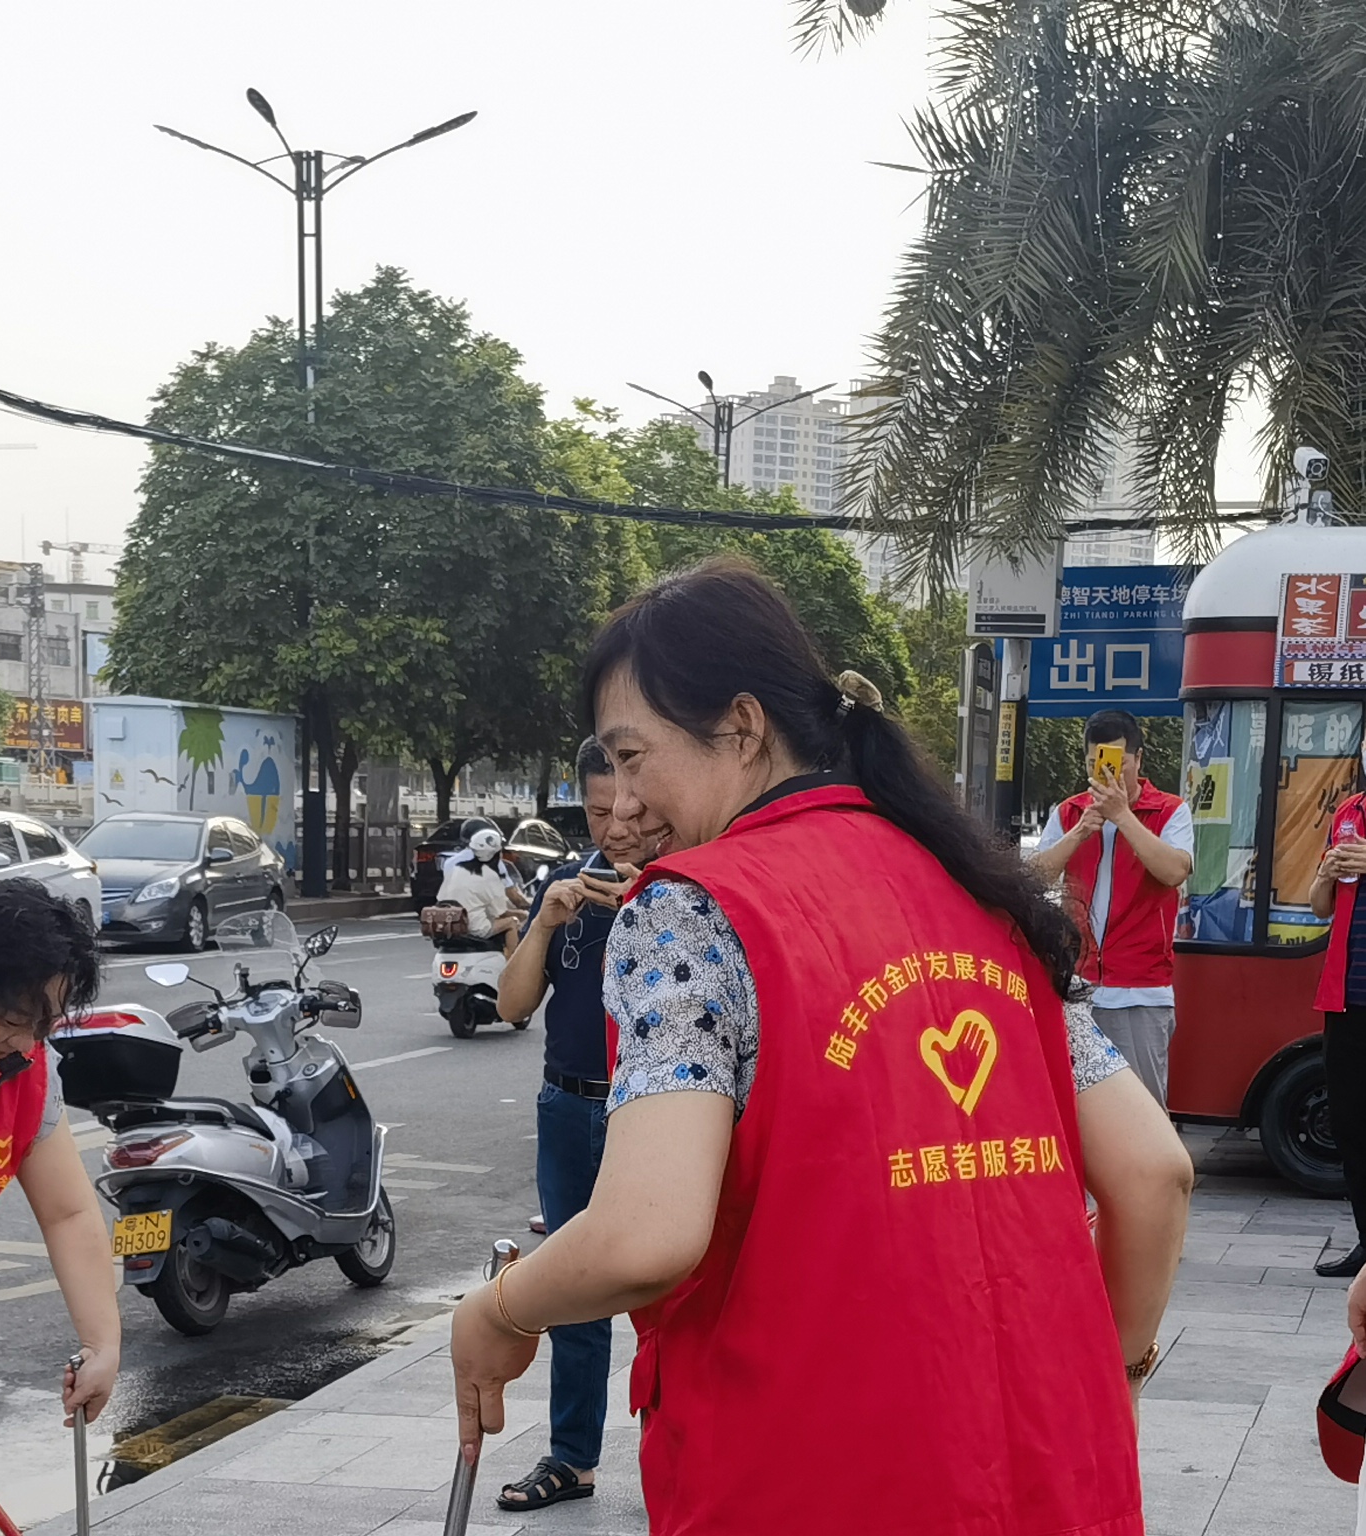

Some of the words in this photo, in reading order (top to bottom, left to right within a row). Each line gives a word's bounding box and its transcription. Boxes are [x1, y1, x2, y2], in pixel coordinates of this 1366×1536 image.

[1061, 611, 1081, 620] ZHI
[1085, 610, 1119, 620] TIANDI
[1123, 609, 1166, 619] PARKING
[1291, 577, 1336, 636] 水果茶
[1050, 639, 1150, 691] 出口
[823, 951, 1035, 1071] 陆丰市金叶发展有限
[888, 1134, 1065, 1188] 志愿者服务队
[114, 1229, 166, 1254] BH309
